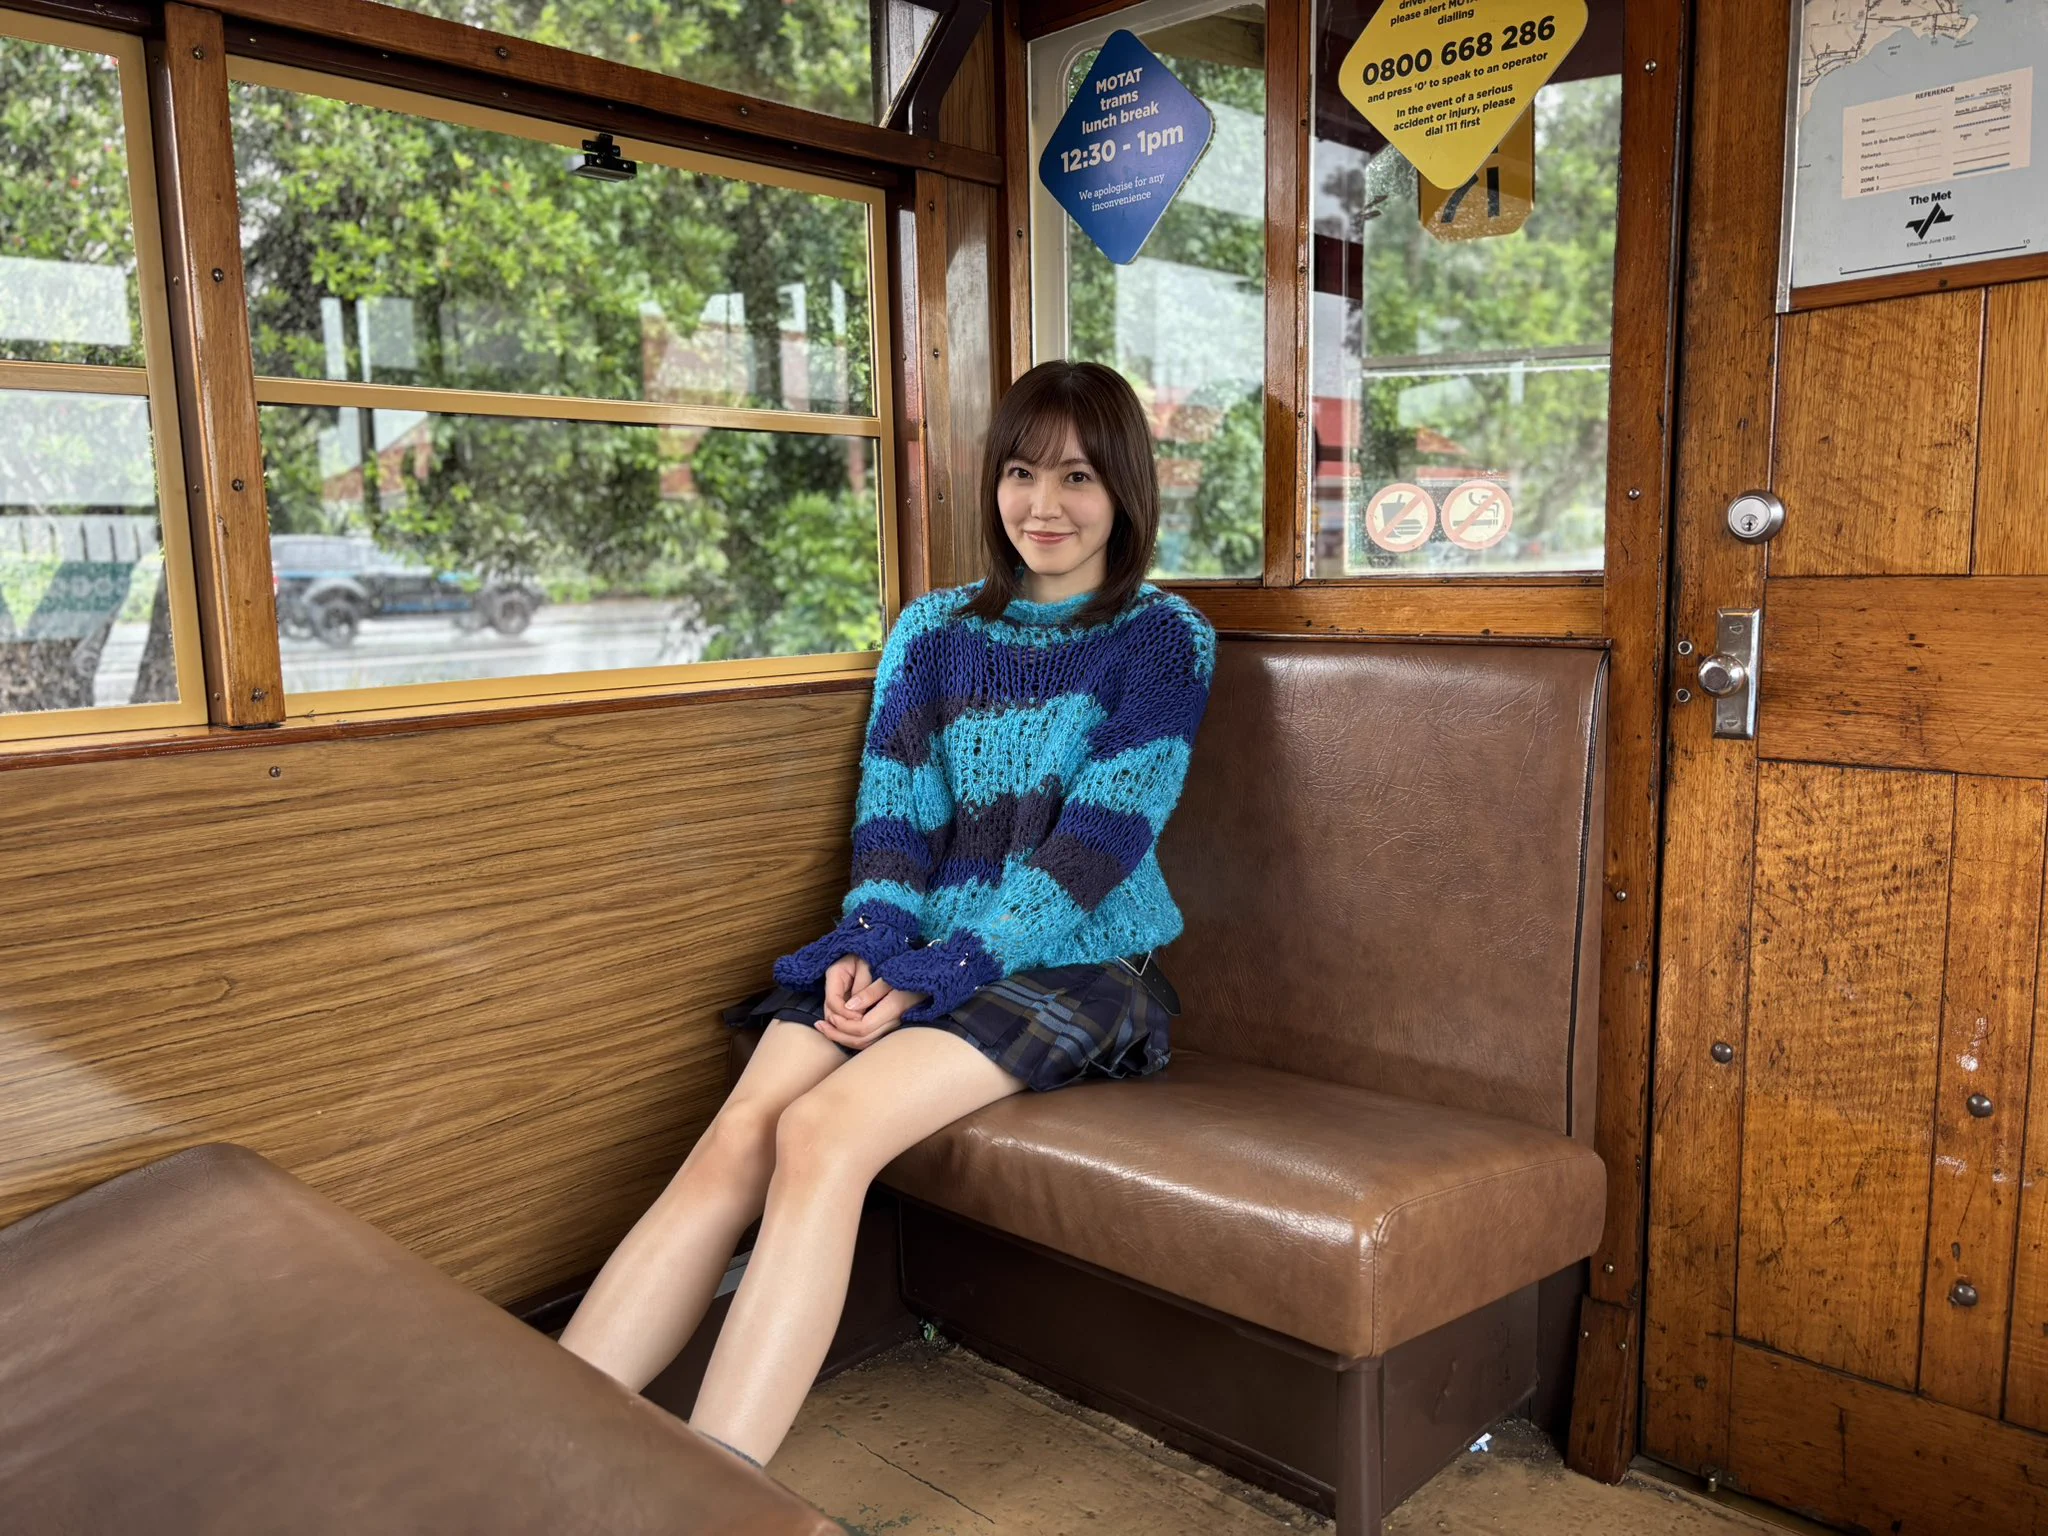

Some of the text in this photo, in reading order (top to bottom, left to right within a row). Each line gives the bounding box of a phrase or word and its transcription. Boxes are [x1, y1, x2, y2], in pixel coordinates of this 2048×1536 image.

[1390, 10, 1421, 27] please
[1423, 2, 1446, 16] alert
[1438, 9, 1474, 25] dialling
[1362, 15, 1556, 86] 0800 668 286
[1096, 67, 1143, 95] MOTAT
[1367, 92, 1385, 103] and
[1387, 86, 1412, 101] press
[1429, 79, 1439, 88] to
[1441, 71, 1471, 86] speak
[1473, 68, 1484, 78] to
[1486, 64, 1499, 74] an
[1501, 51, 1548, 71] operator
[1100, 90, 1139, 111] trams
[1396, 82, 1513, 118] In the event of a serious
[1915, 86, 1955, 100] REFERENCE
[1082, 101, 1160, 135] lunch break
[1393, 96, 1516, 132] accident or injury, please
[1425, 117, 1481, 137] dial 111 first
[1060, 124, 1184, 174] 12:30 - 1pm
[1078, 173, 1165, 200] We apologise for any
[1909, 190, 1952, 206] The Met
[1091, 190, 1152, 212] inconvenience
